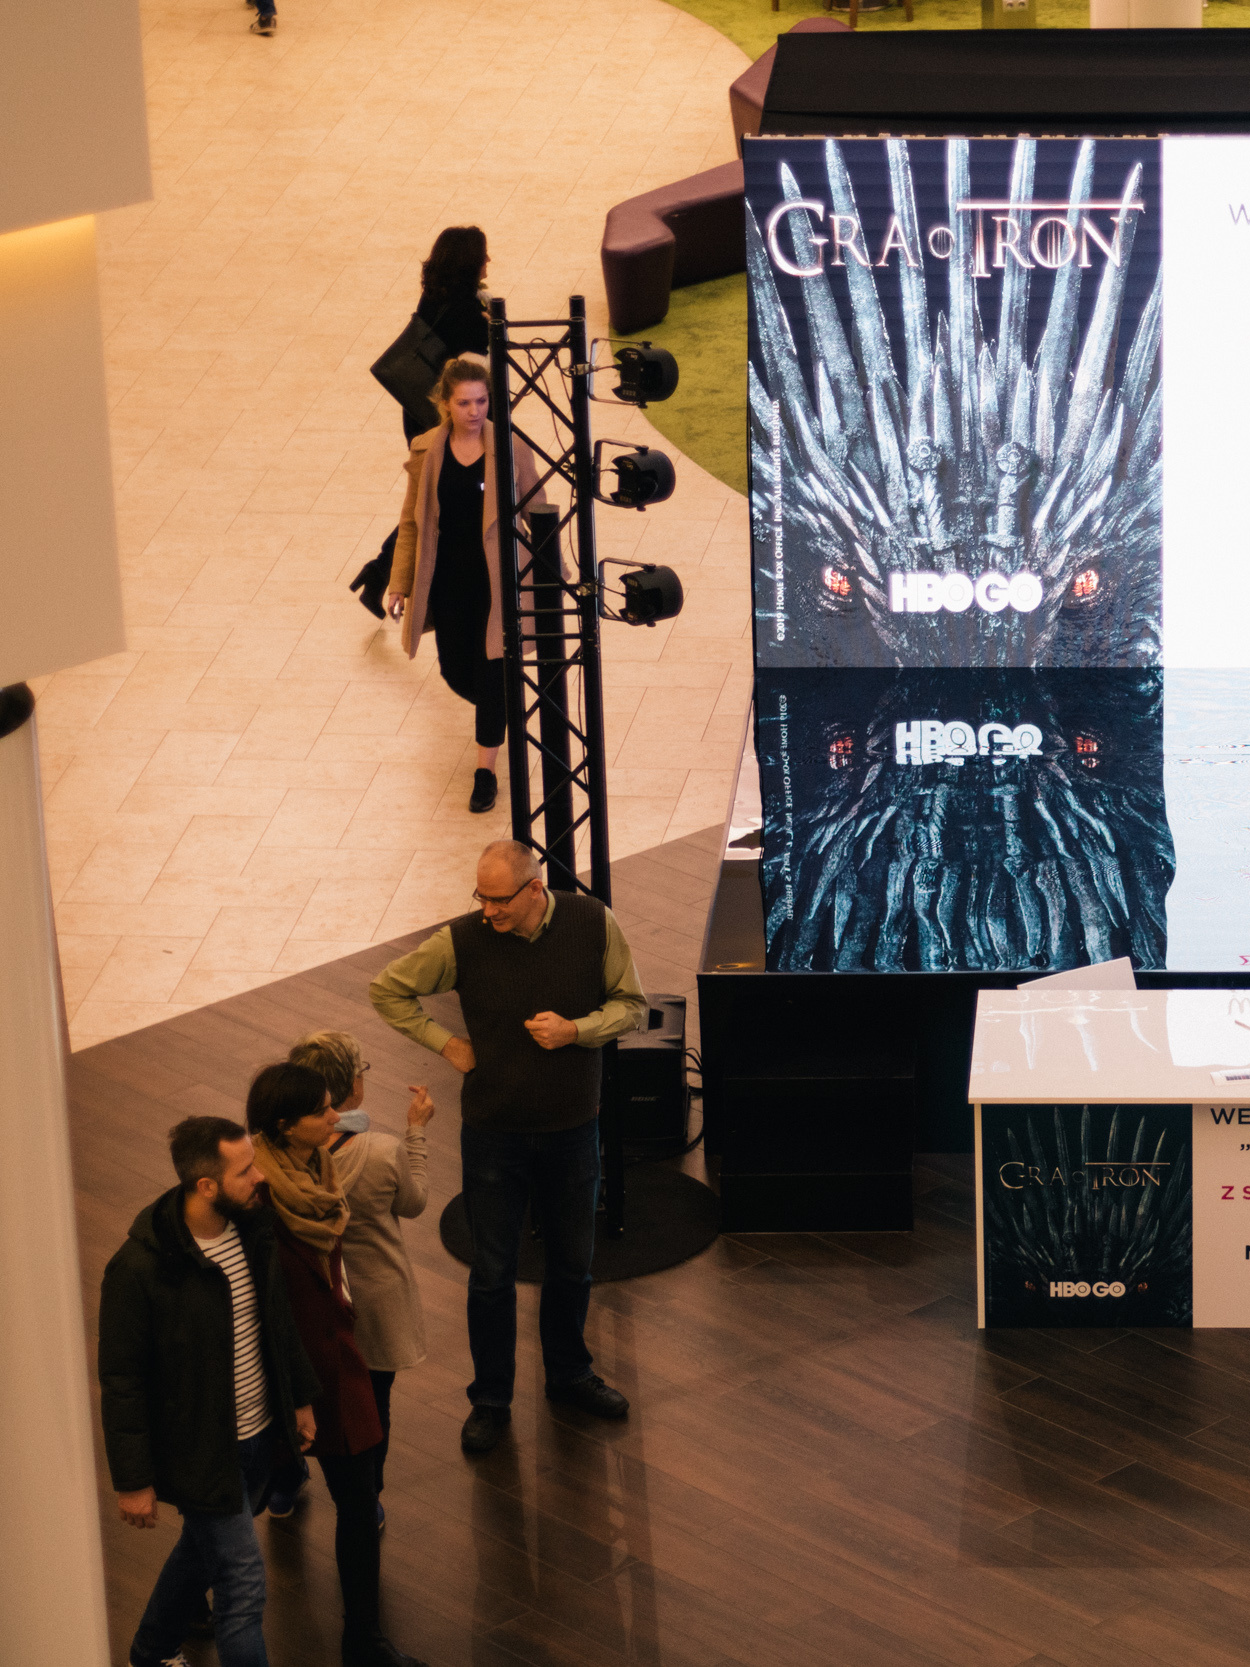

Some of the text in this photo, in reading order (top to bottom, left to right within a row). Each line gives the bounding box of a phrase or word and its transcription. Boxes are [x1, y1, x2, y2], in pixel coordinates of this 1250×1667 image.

[767, 202, 1145, 278] GRA O TRON
[774, 560, 784, 579] BOX
[776, 582, 785, 610] HOME
[998, 1161, 1067, 1190] GRA
[1085, 1162, 1170, 1190] TRON
[1220, 1184, 1234, 1201] Z
